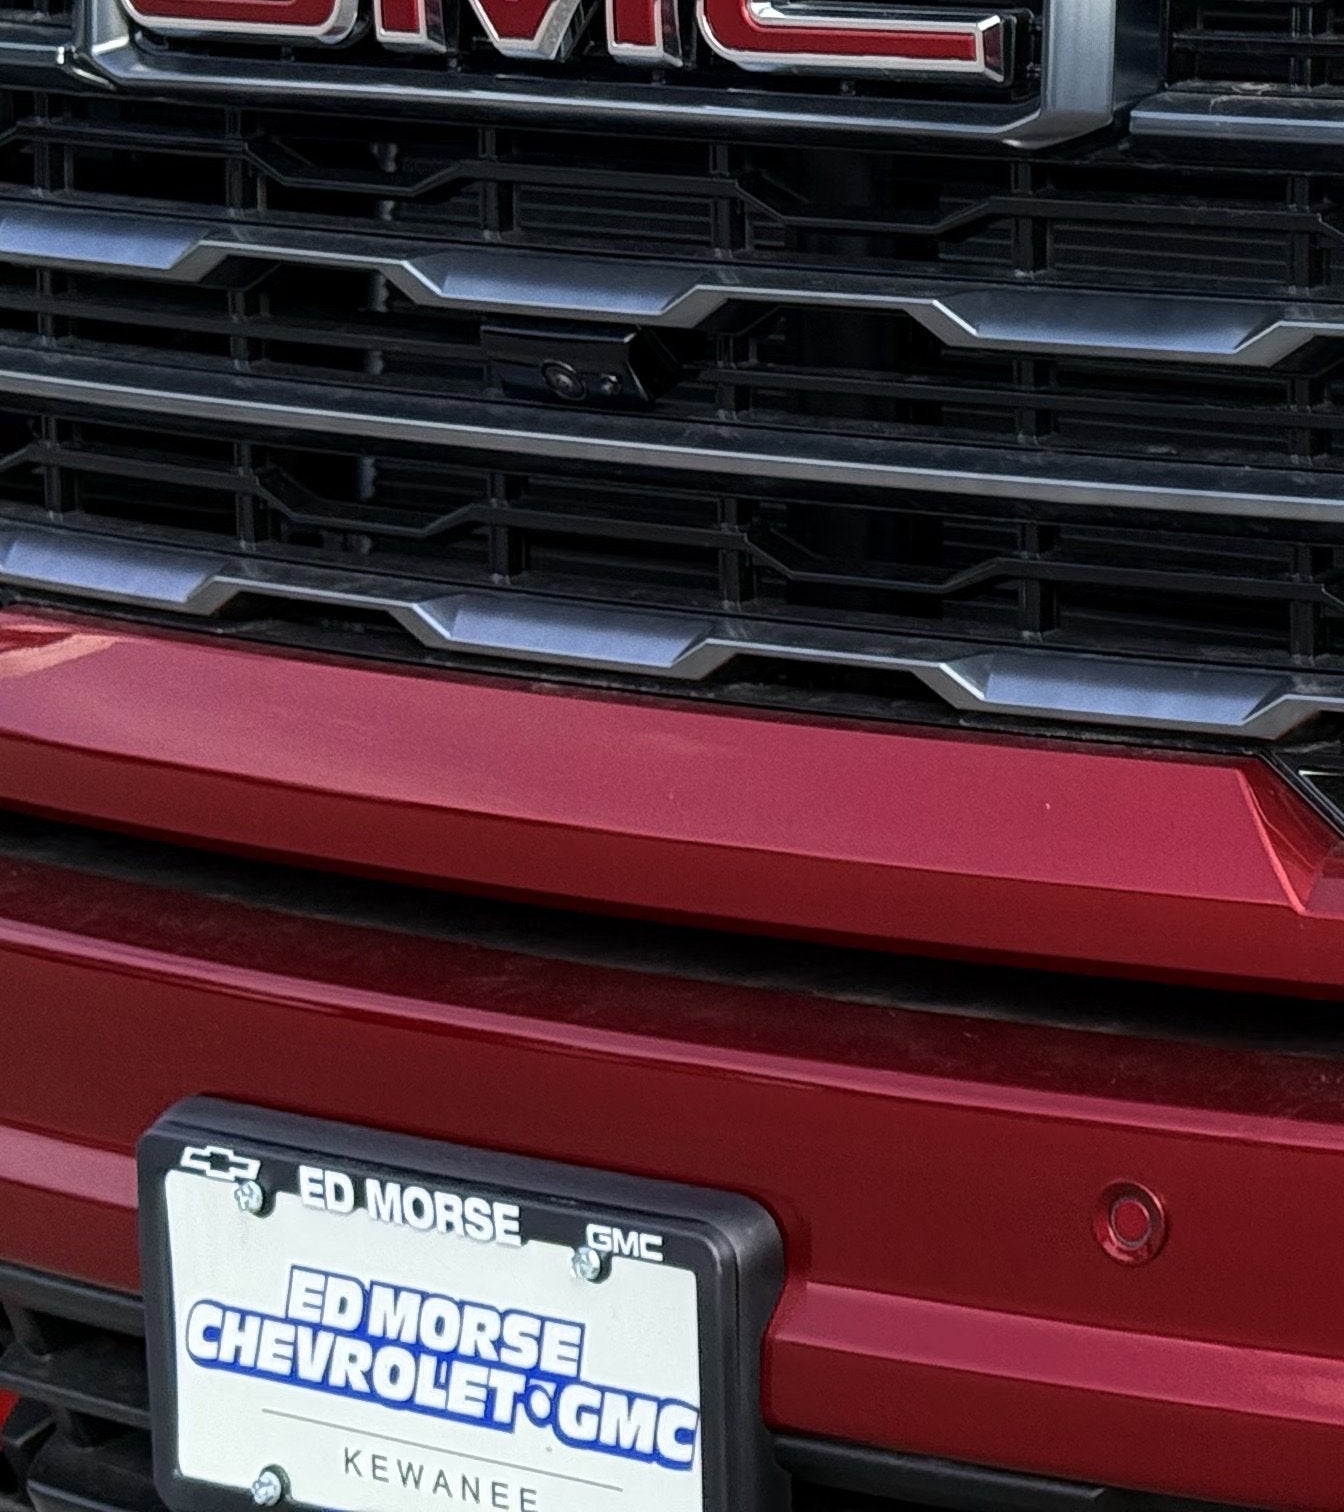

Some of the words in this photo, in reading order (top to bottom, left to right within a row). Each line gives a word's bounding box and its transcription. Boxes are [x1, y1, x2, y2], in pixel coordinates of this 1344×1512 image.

[299, 1165, 355, 1214] ED
[364, 1178, 523, 1246] MORSE
[585, 1223, 664, 1262] GMC
[286, 1267, 365, 1331] ED
[367, 1281, 586, 1377] MORSE
[343, 1446, 540, 1512] KEWANEE
